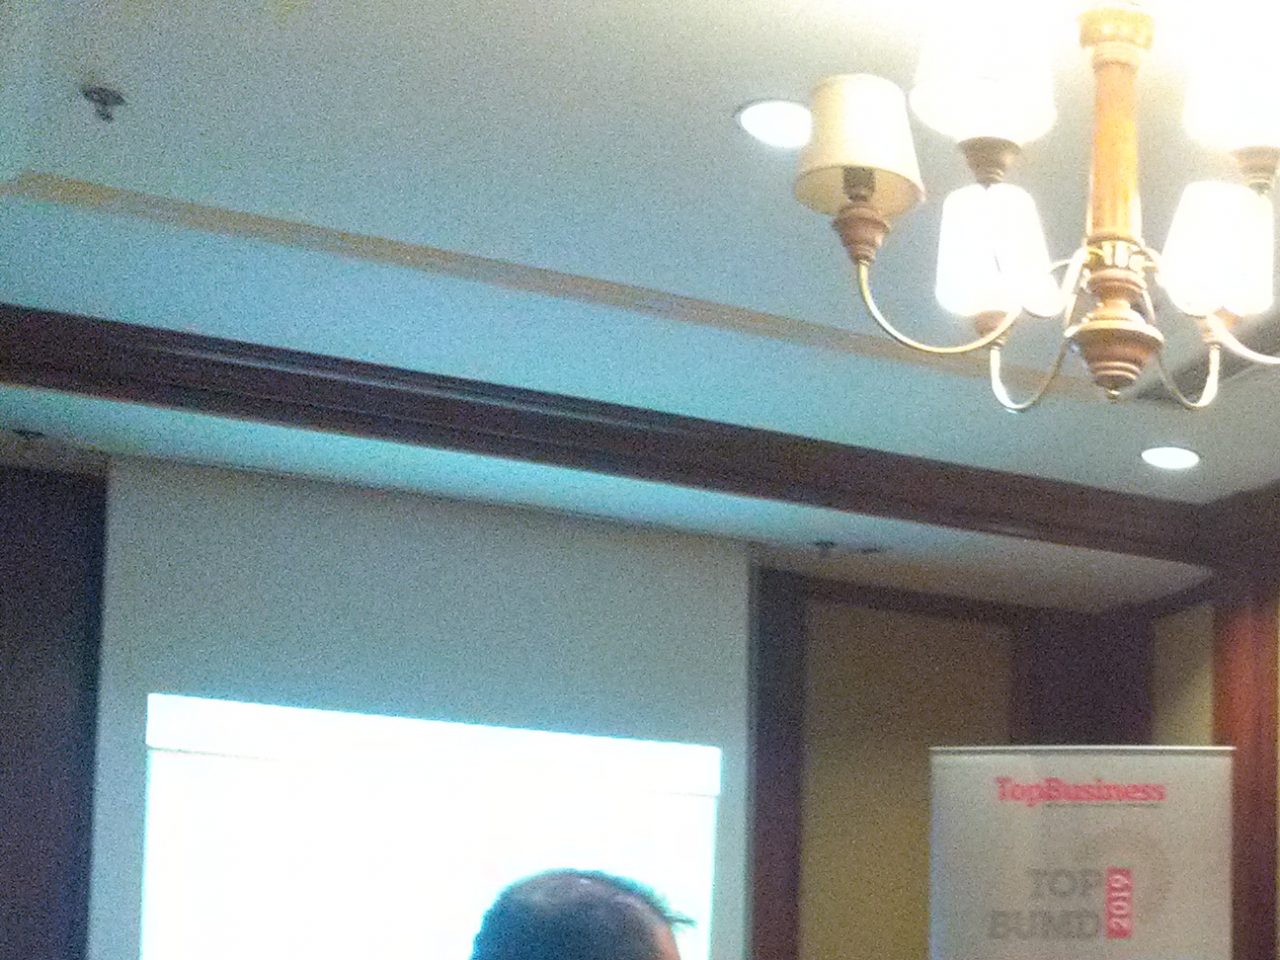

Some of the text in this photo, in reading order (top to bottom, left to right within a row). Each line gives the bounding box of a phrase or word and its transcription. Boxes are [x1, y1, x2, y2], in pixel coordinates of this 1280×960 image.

[995, 776, 1166, 807] TopBusiness
[1028, 868, 1101, 898] TOP
[1109, 872, 1131, 930] 2019
[988, 909, 1100, 939] BUMD
